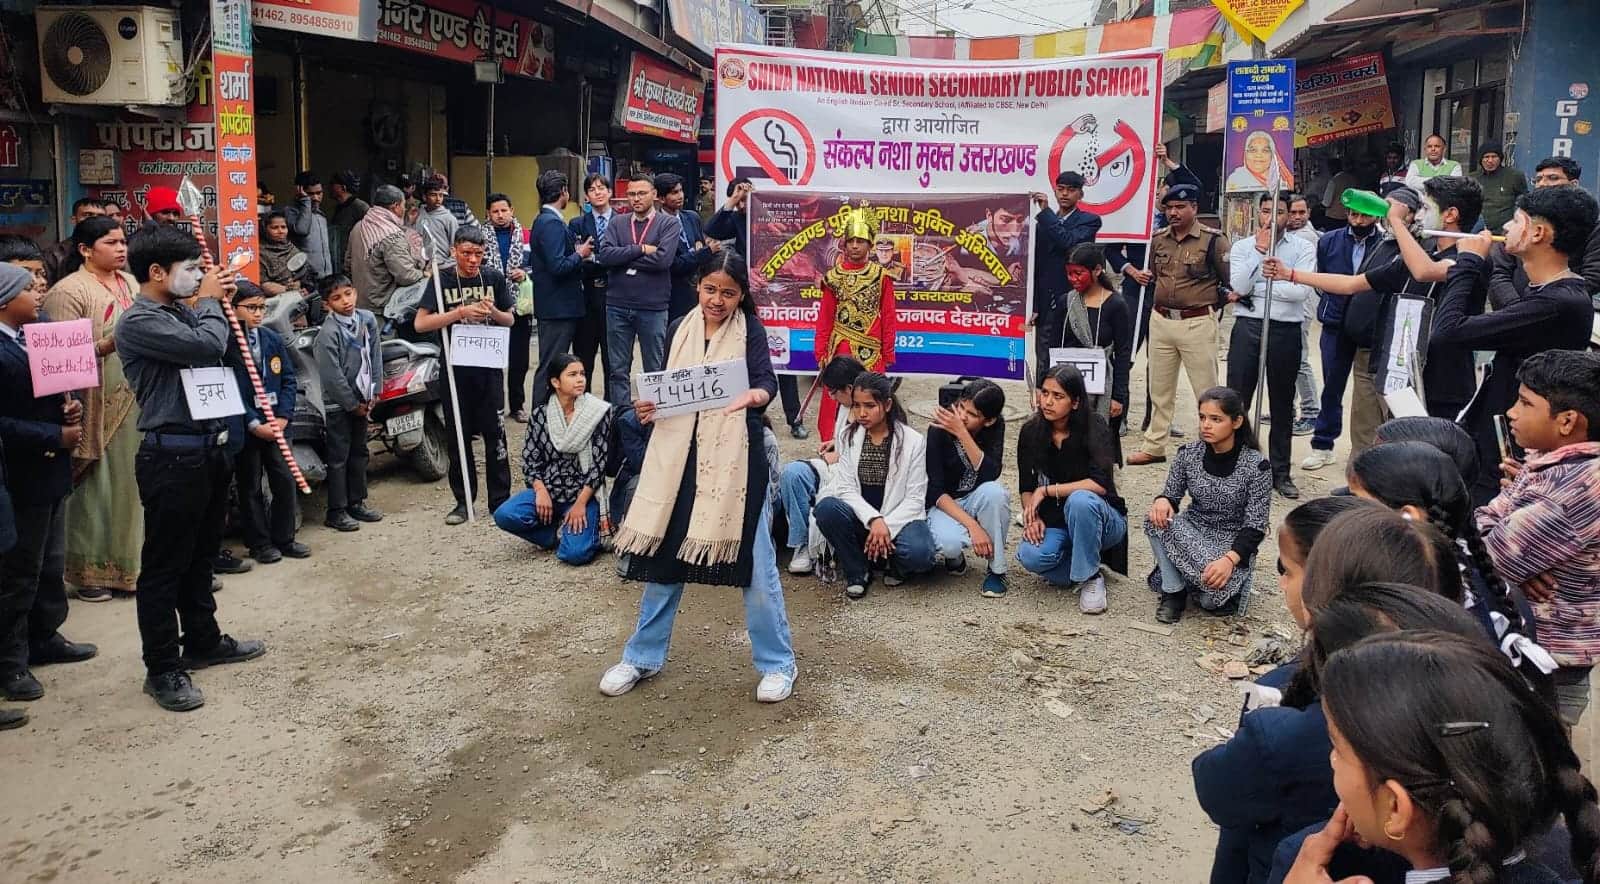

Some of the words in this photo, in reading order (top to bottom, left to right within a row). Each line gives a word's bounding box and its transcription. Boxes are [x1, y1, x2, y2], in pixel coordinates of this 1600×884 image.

[220, 60, 250, 100] शर्मा
[748, 62, 792, 91] SHIVA
[797, 63, 867, 96] NATIONAL
[870, 69, 925, 97] SENIOR
[928, 70, 1022, 98] SECONDARY
[1024, 68, 1083, 97] PUBLIC
[1086, 65, 1150, 97] SCHOOL
[902, 100, 933, 109] Secondary
[881, 116, 911, 135] द्वारा
[913, 113, 979, 135] आयोजित
[823, 129, 876, 170] संकल्प
[879, 141, 911, 171] नशा
[916, 142, 956, 188] मुक्त
[959, 143, 1038, 176] उत्तराखण्ड
[761, 220, 827, 280] उत्तराखण्ड
[876, 205, 909, 223] नशा
[912, 208, 955, 237] मुक्ति
[955, 229, 1012, 286] अभियान
[444, 285, 495, 305] ALPHA
[910, 291, 973, 303] उत्तराखण्ड
[896, 310, 946, 325] जनपद
[950, 306, 1012, 335] देहरादून
[456, 335, 503, 355] तम्बाकू
[654, 379, 724, 406] 14416
